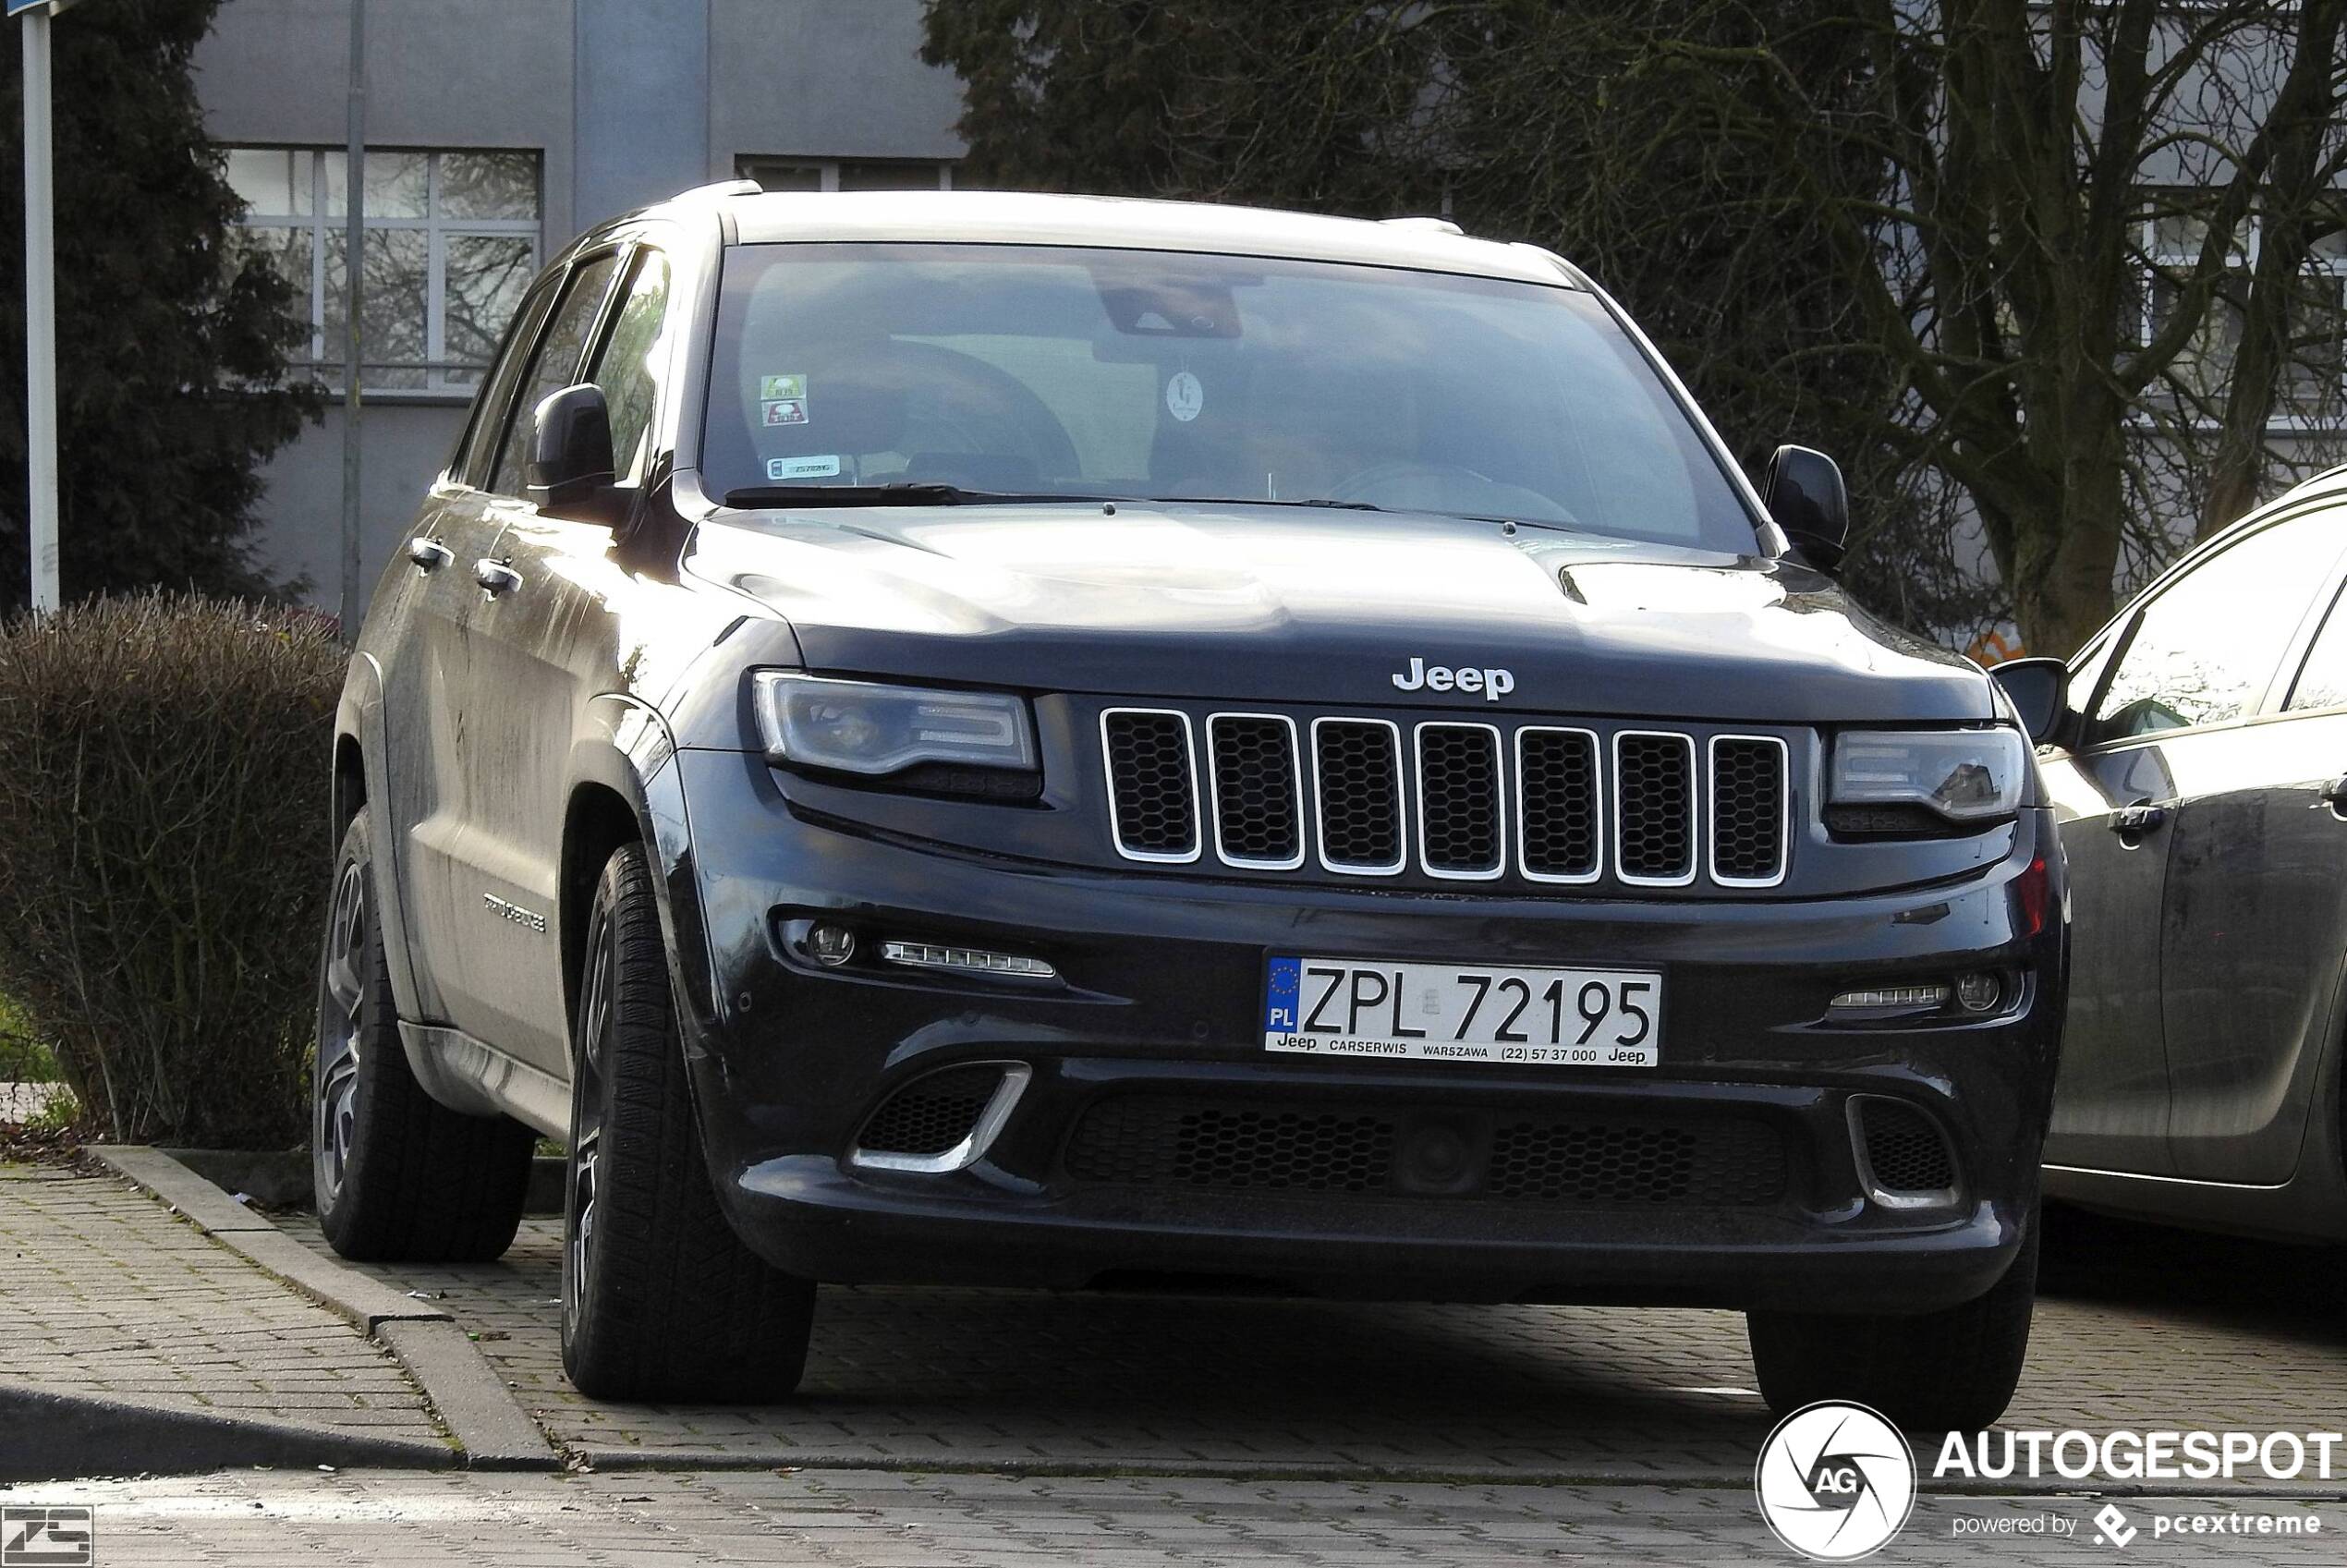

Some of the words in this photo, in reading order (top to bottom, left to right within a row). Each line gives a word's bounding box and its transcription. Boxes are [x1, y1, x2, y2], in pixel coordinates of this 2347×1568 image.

[1392, 657, 1515, 701] Jeep
[1270, 1008, 1294, 1027] PL
[1304, 967, 1427, 1039] ZPL
[1453, 975, 1652, 1047] 72195
[1277, 1032, 1317, 1051] Jeep
[1330, 1039, 1407, 1054] CARSERWIS
[1423, 1044, 1489, 1058] WARSZAWA
[1502, 1047, 1527, 1062] (22)
[1531, 1049, 1548, 1061] 57
[1551, 1050, 1568, 1061] 37
[1572, 1050, 1598, 1062] 000
[1608, 1048, 1646, 1064] Jeep
